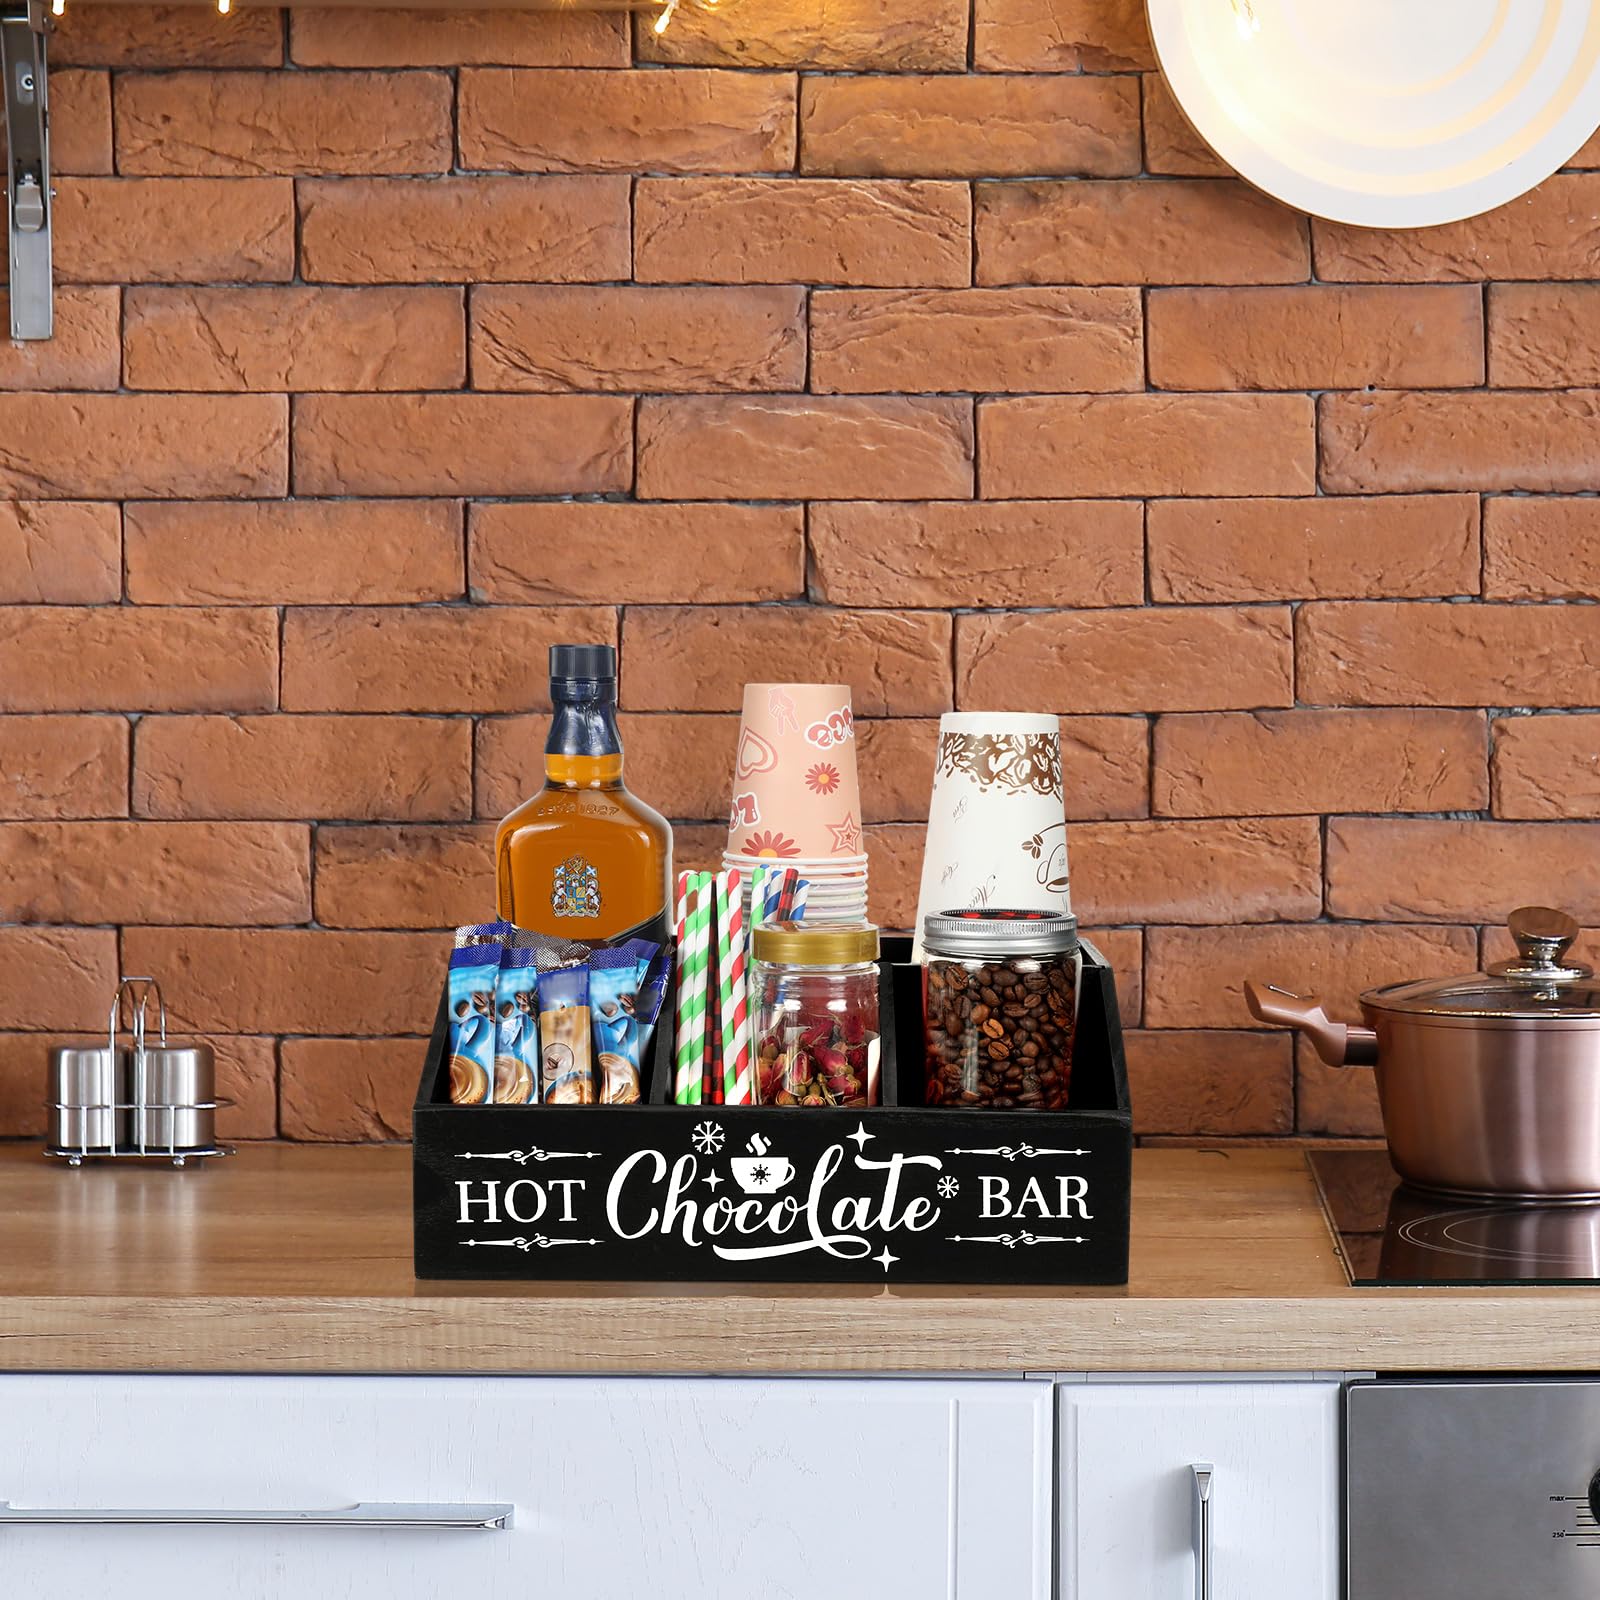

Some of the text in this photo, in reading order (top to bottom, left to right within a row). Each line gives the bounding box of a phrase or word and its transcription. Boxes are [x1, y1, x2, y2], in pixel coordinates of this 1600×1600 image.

[455, 1143, 1094, 1261] HOT Chocolate BAR
